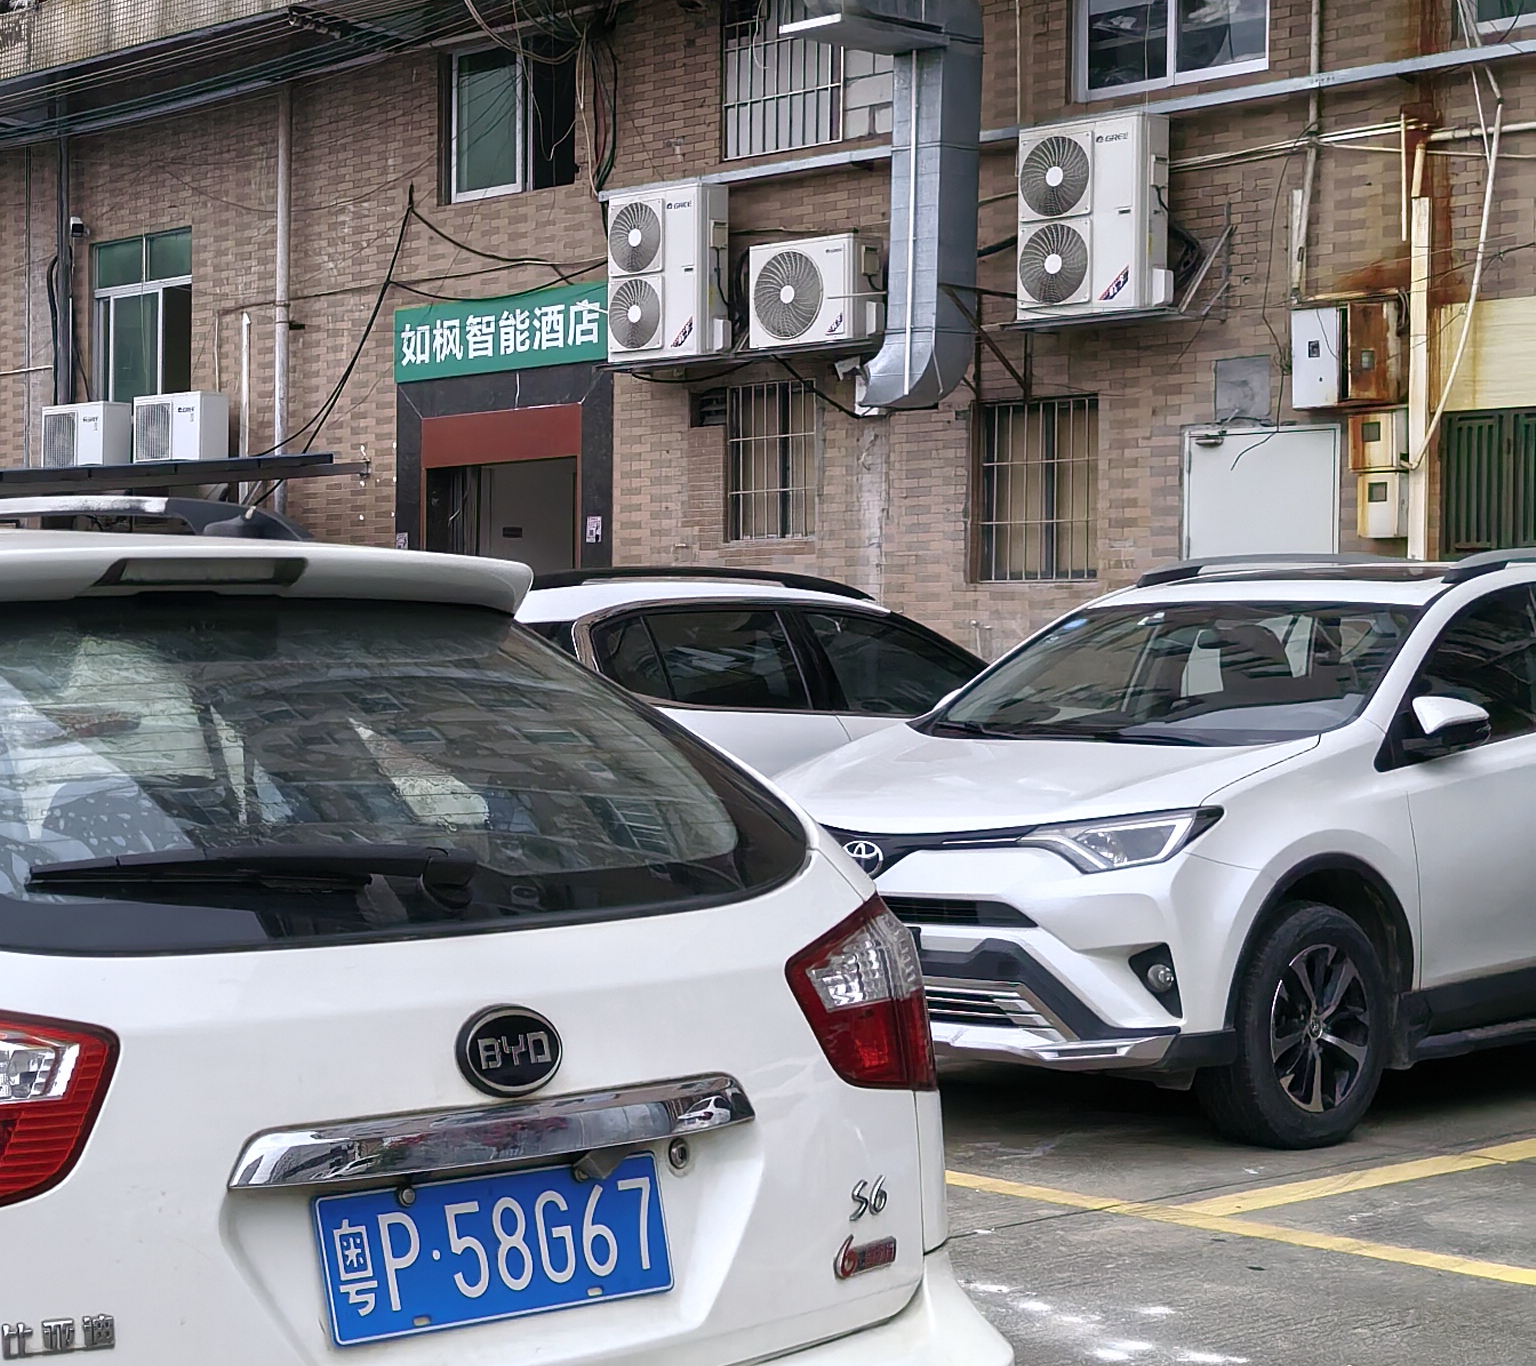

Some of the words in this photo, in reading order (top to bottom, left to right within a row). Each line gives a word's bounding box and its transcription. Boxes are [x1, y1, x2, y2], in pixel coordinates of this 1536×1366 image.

[401, 299, 601, 367] 如枫智能酒店
[477, 1031, 552, 1070] BYD
[849, 1175, 888, 1222] S6
[1, 1314, 115, 1360] 比亚迪
